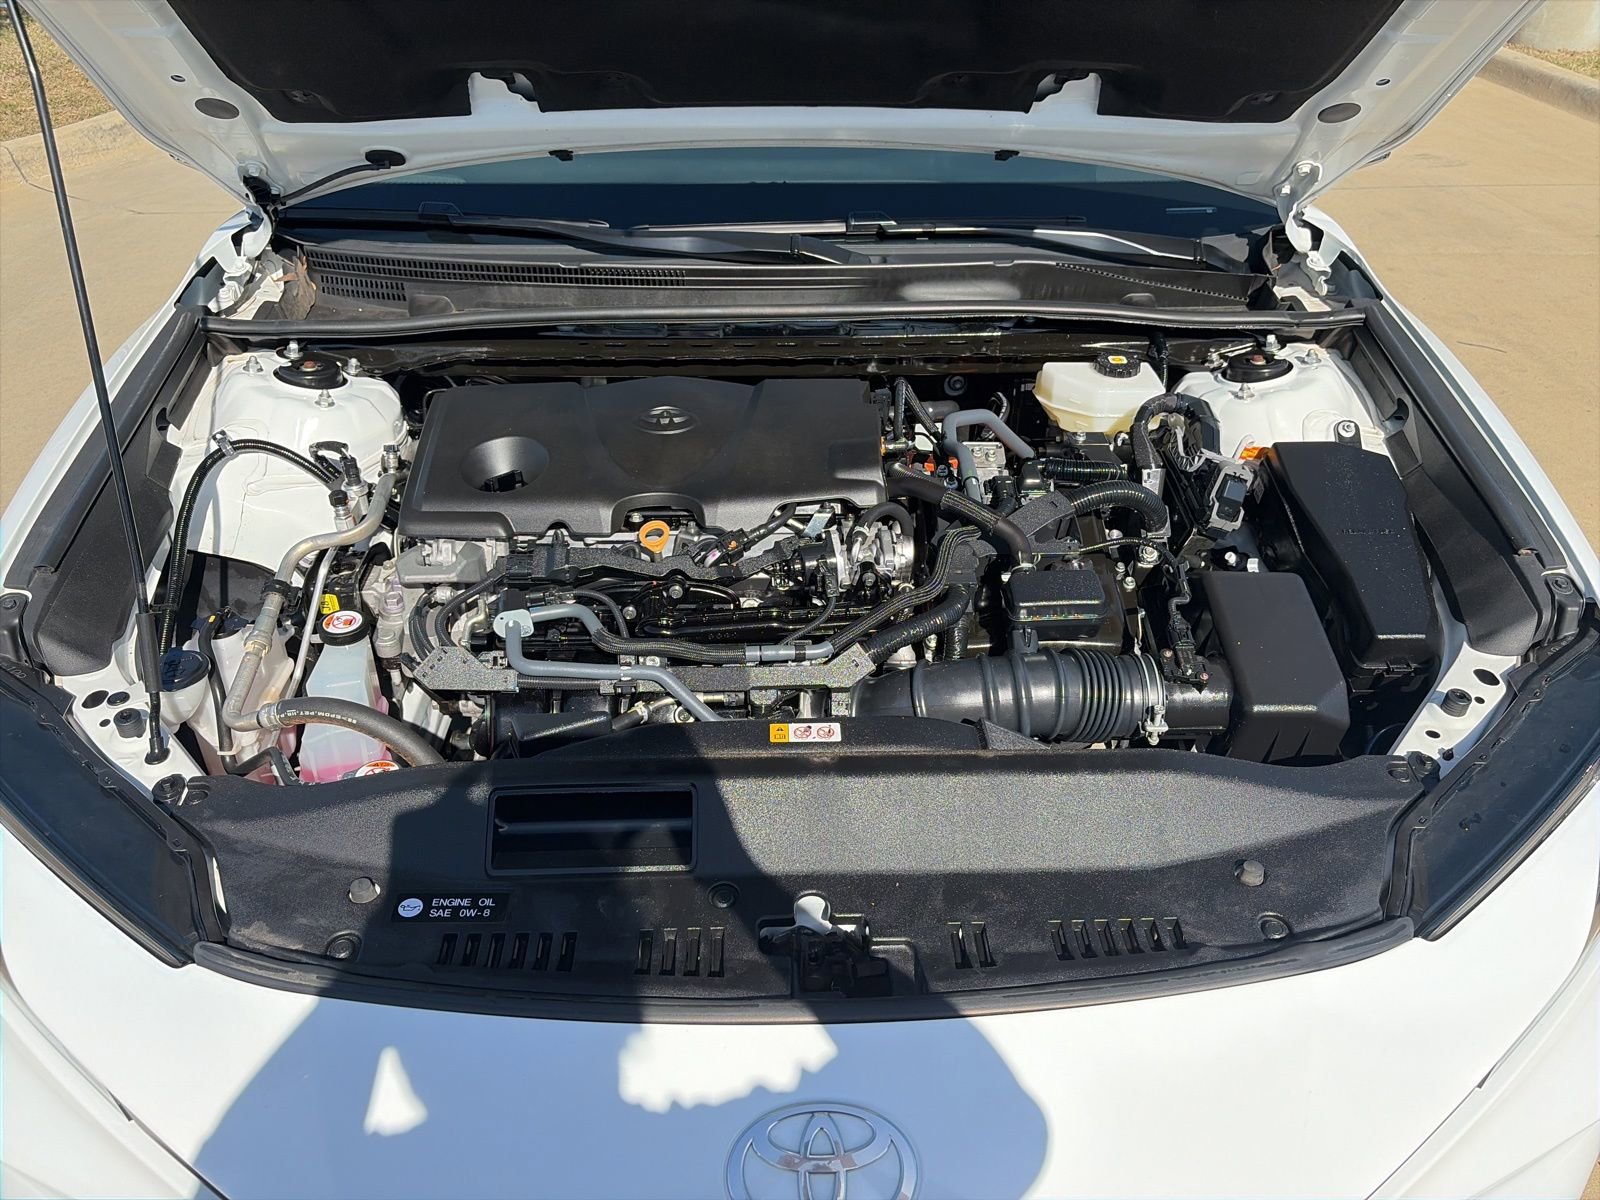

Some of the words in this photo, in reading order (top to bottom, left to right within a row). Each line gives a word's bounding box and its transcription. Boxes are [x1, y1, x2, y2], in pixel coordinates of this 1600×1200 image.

[431, 898, 472, 907] ENGINE
[478, 898, 496, 907] OIL
[428, 908, 452, 918] SAE
[459, 908, 491, 917] 0W-8
